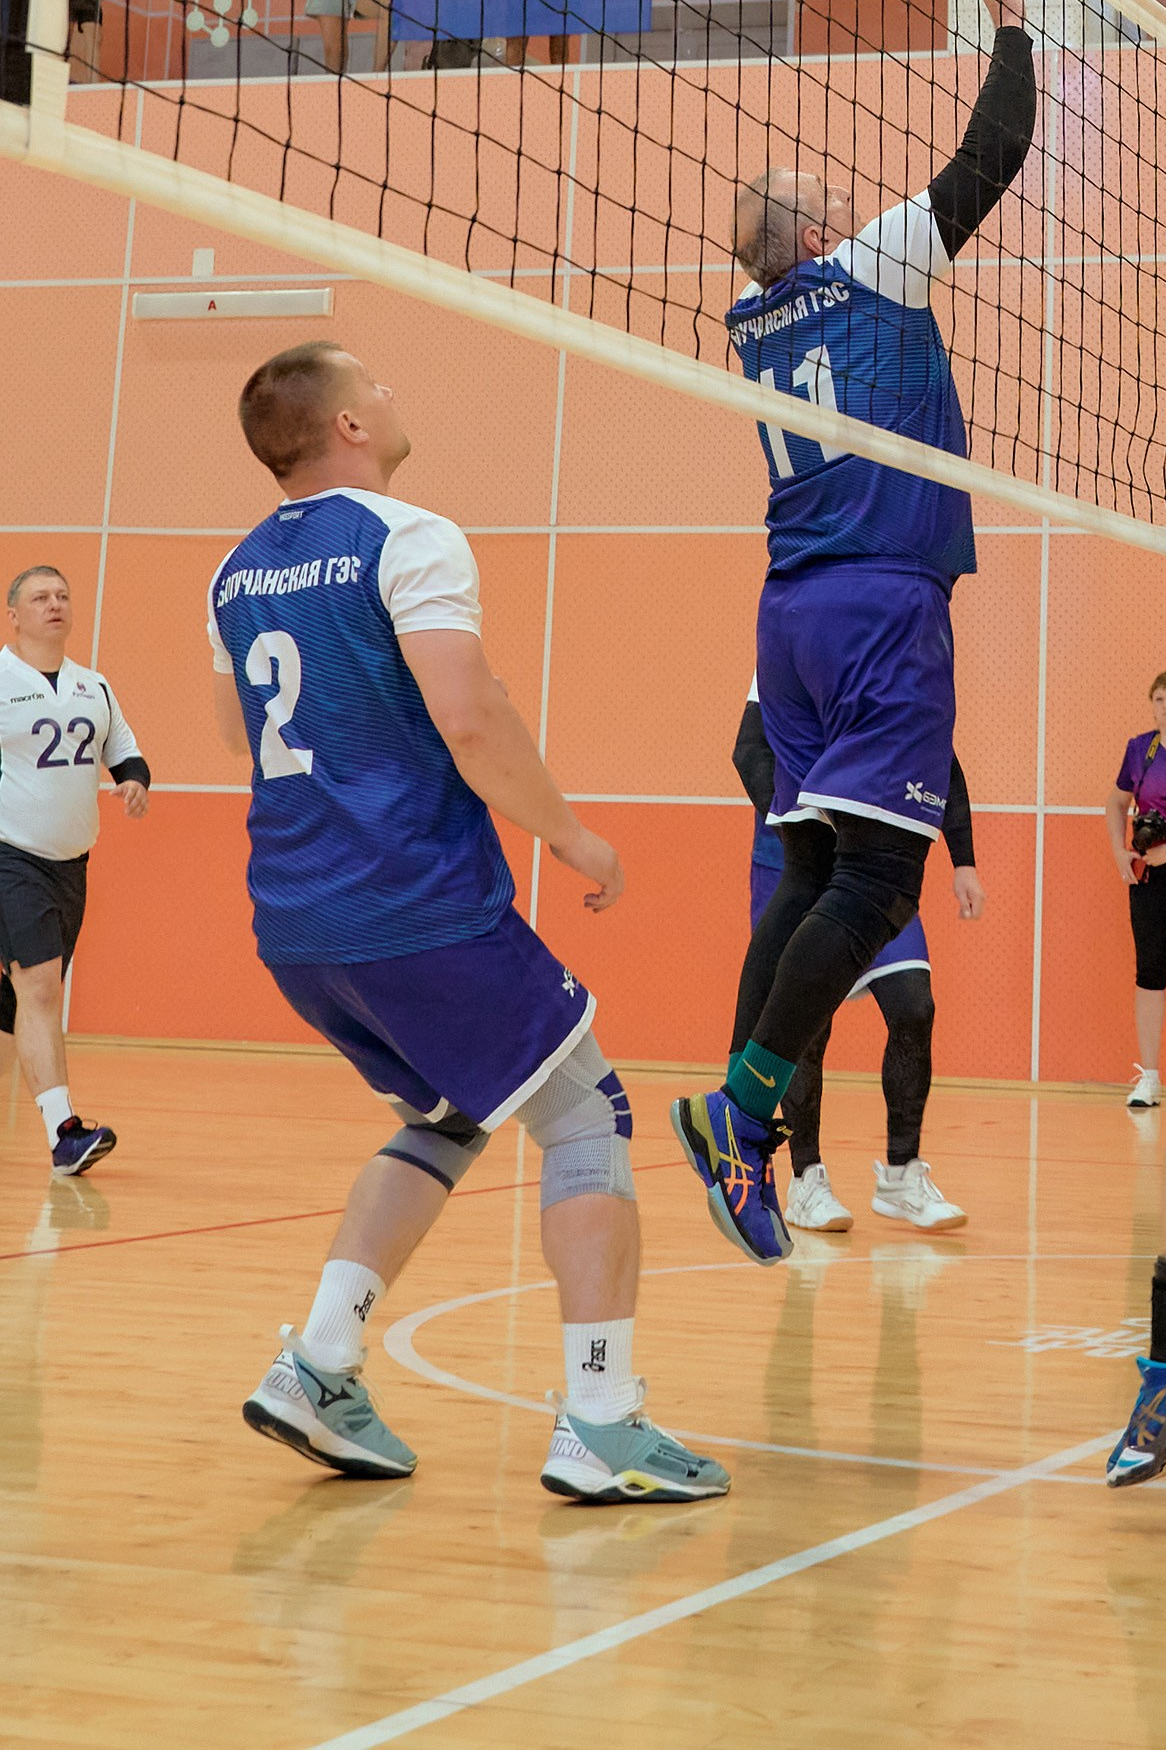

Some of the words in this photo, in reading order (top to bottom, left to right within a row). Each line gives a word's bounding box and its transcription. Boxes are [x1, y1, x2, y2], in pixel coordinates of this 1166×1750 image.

[324, 556, 362, 585] ГЭС
[245, 630, 314, 780] 2
[31, 716, 96, 769] 22
